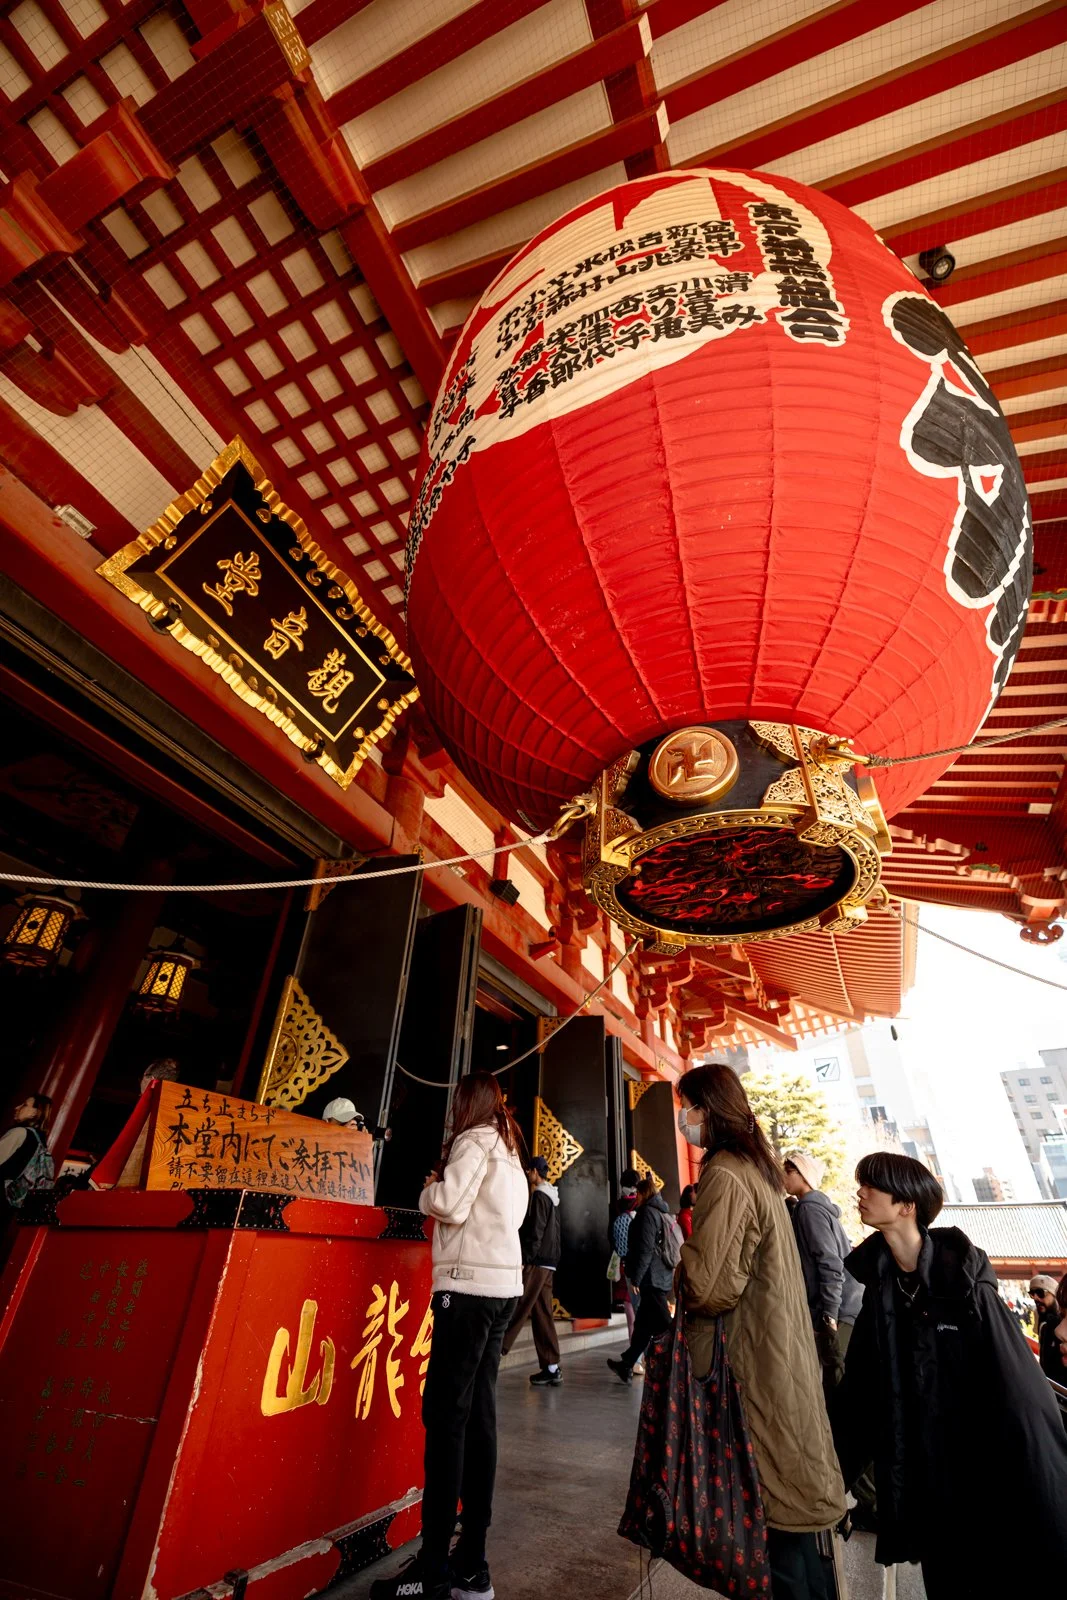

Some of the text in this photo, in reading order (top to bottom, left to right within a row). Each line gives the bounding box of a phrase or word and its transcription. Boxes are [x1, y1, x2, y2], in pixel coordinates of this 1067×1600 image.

[638, 231, 675, 271] 吉兆
[698, 220, 741, 256] 金田中
[602, 240, 639, 285] 松山
[680, 277, 725, 333] 小喜美
[715, 272, 764, 326] 清み
[578, 305, 616, 368] 加津代
[174, 1088, 277, 1126] 立ち止まらず
[166, 1113, 371, 1185] 本堂内にてご参拝下さい
[396, 1581, 424, 1596] HOKA
